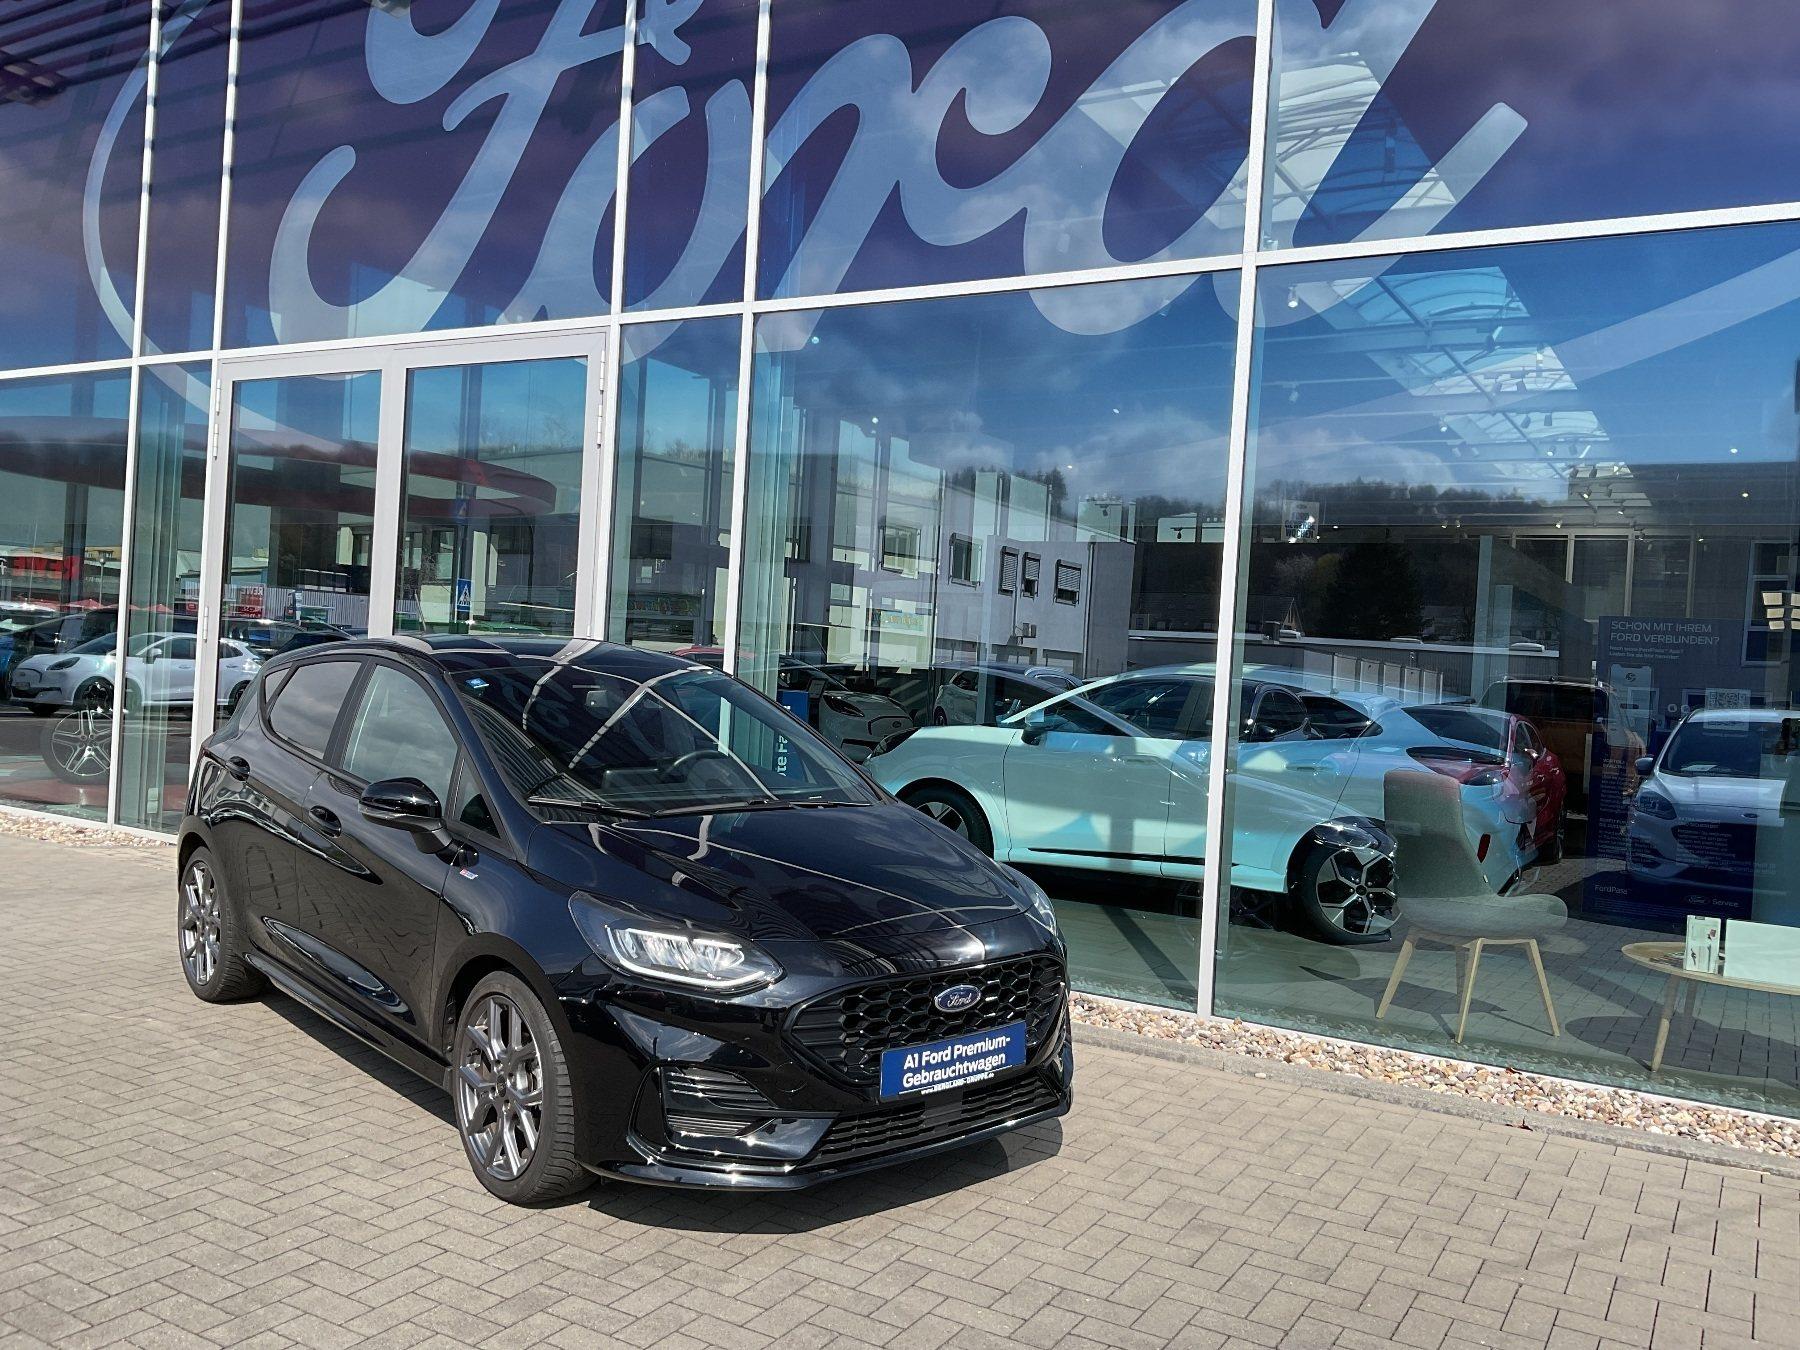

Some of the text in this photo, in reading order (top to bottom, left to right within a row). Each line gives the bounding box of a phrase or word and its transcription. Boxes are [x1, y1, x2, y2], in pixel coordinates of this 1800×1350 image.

[269, 0, 1529, 378] Ford
[1611, 621, 1712, 633] SCHON MIT IHREM
[1610, 632, 1720, 645] FORD VERBUNDEN?
[1712, 898, 1739, 908] Service
[947, 992, 972, 1008] Ford
[903, 1035, 1011, 1070] A1 Ford Premium-
[902, 1053, 1006, 1088] Gebrauchtwagen
